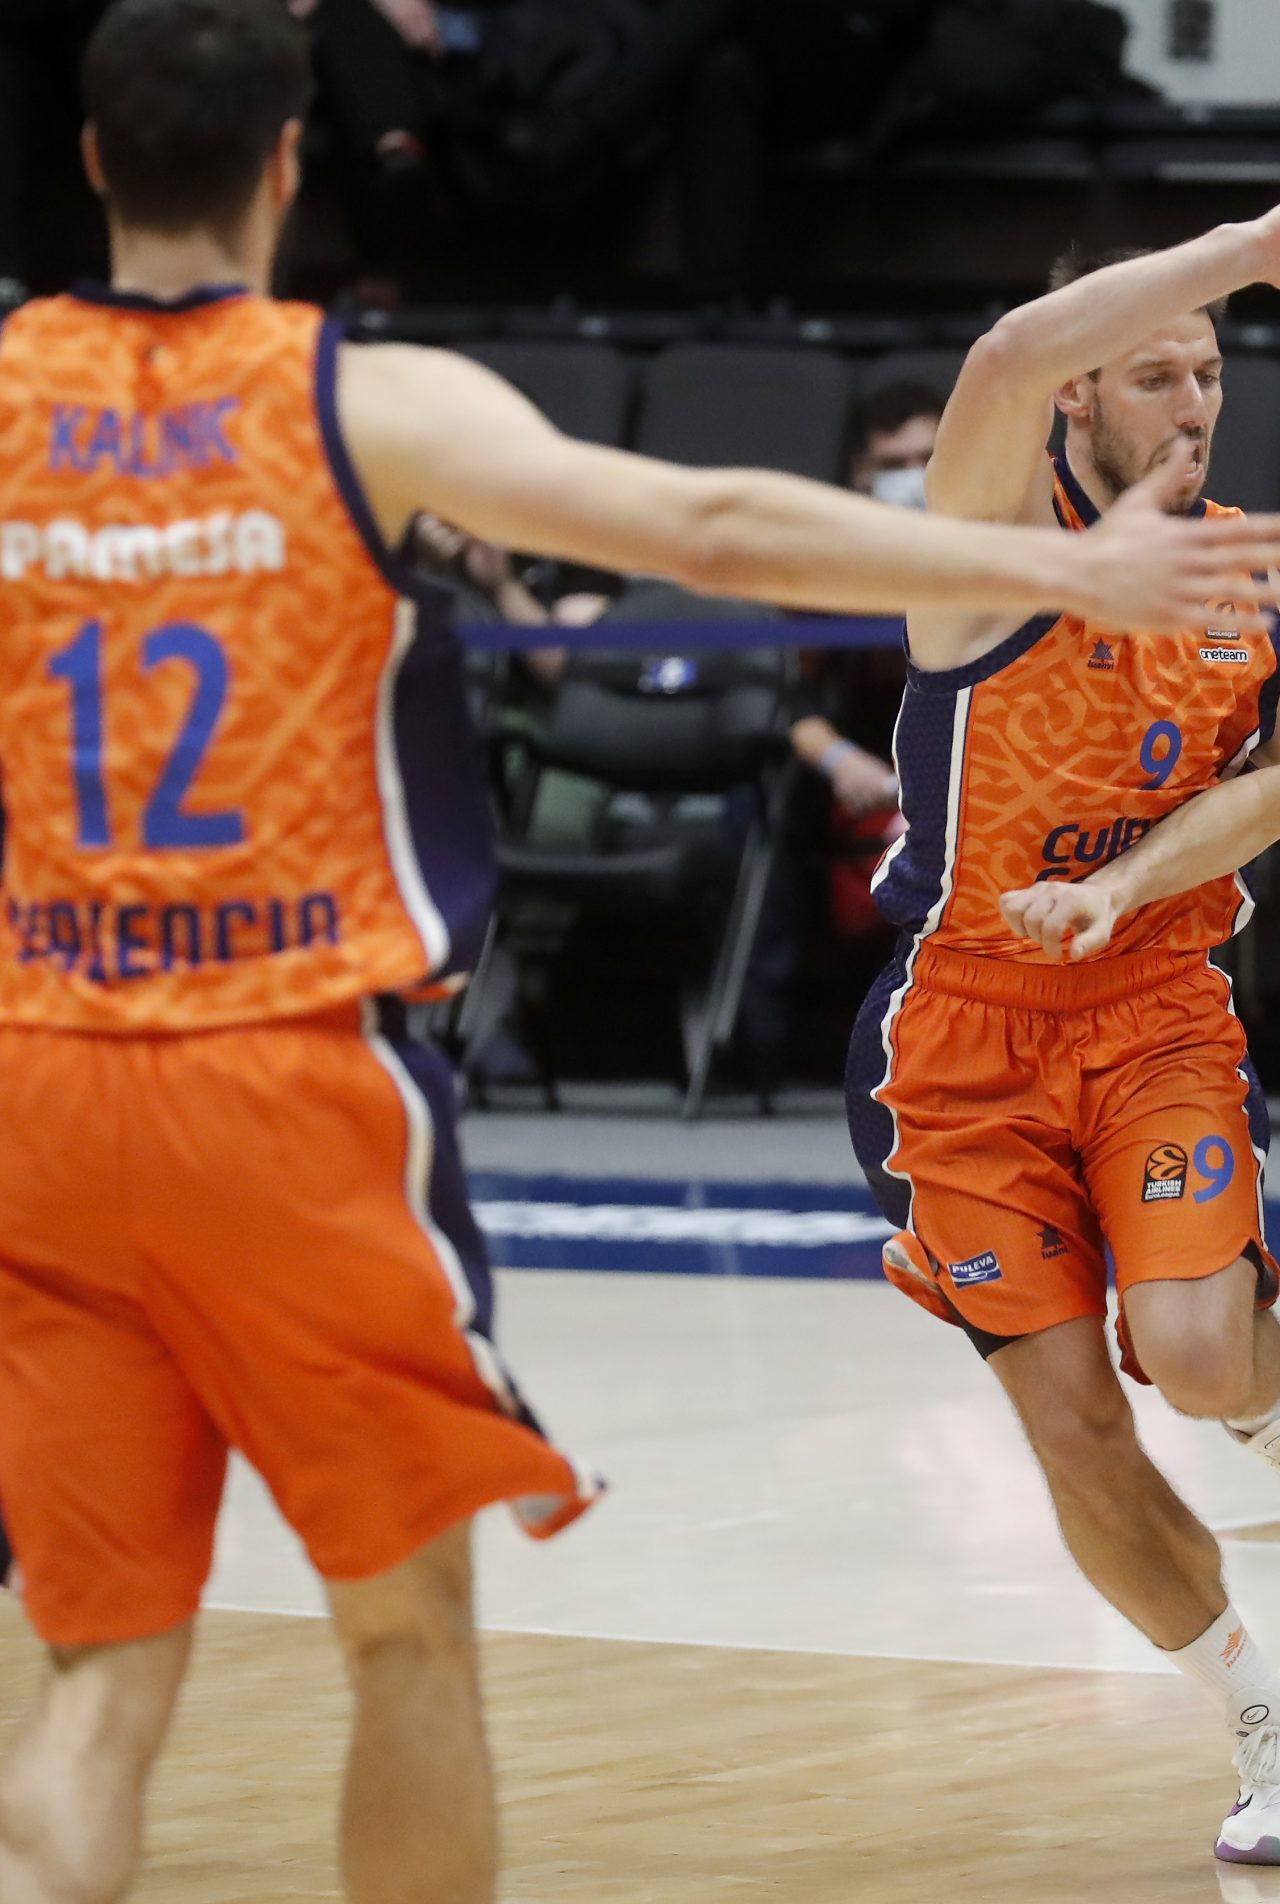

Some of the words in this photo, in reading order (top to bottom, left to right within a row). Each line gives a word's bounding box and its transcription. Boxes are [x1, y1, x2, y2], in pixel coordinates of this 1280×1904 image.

[0, 511, 285, 581] PAMESA
[1200, 646, 1248, 662] oneteam
[48, 620, 245, 848] 12
[1139, 720, 1183, 791] 9
[1193, 1134, 1235, 1204] 9
[952, 1255, 994, 1273] PULEVA
